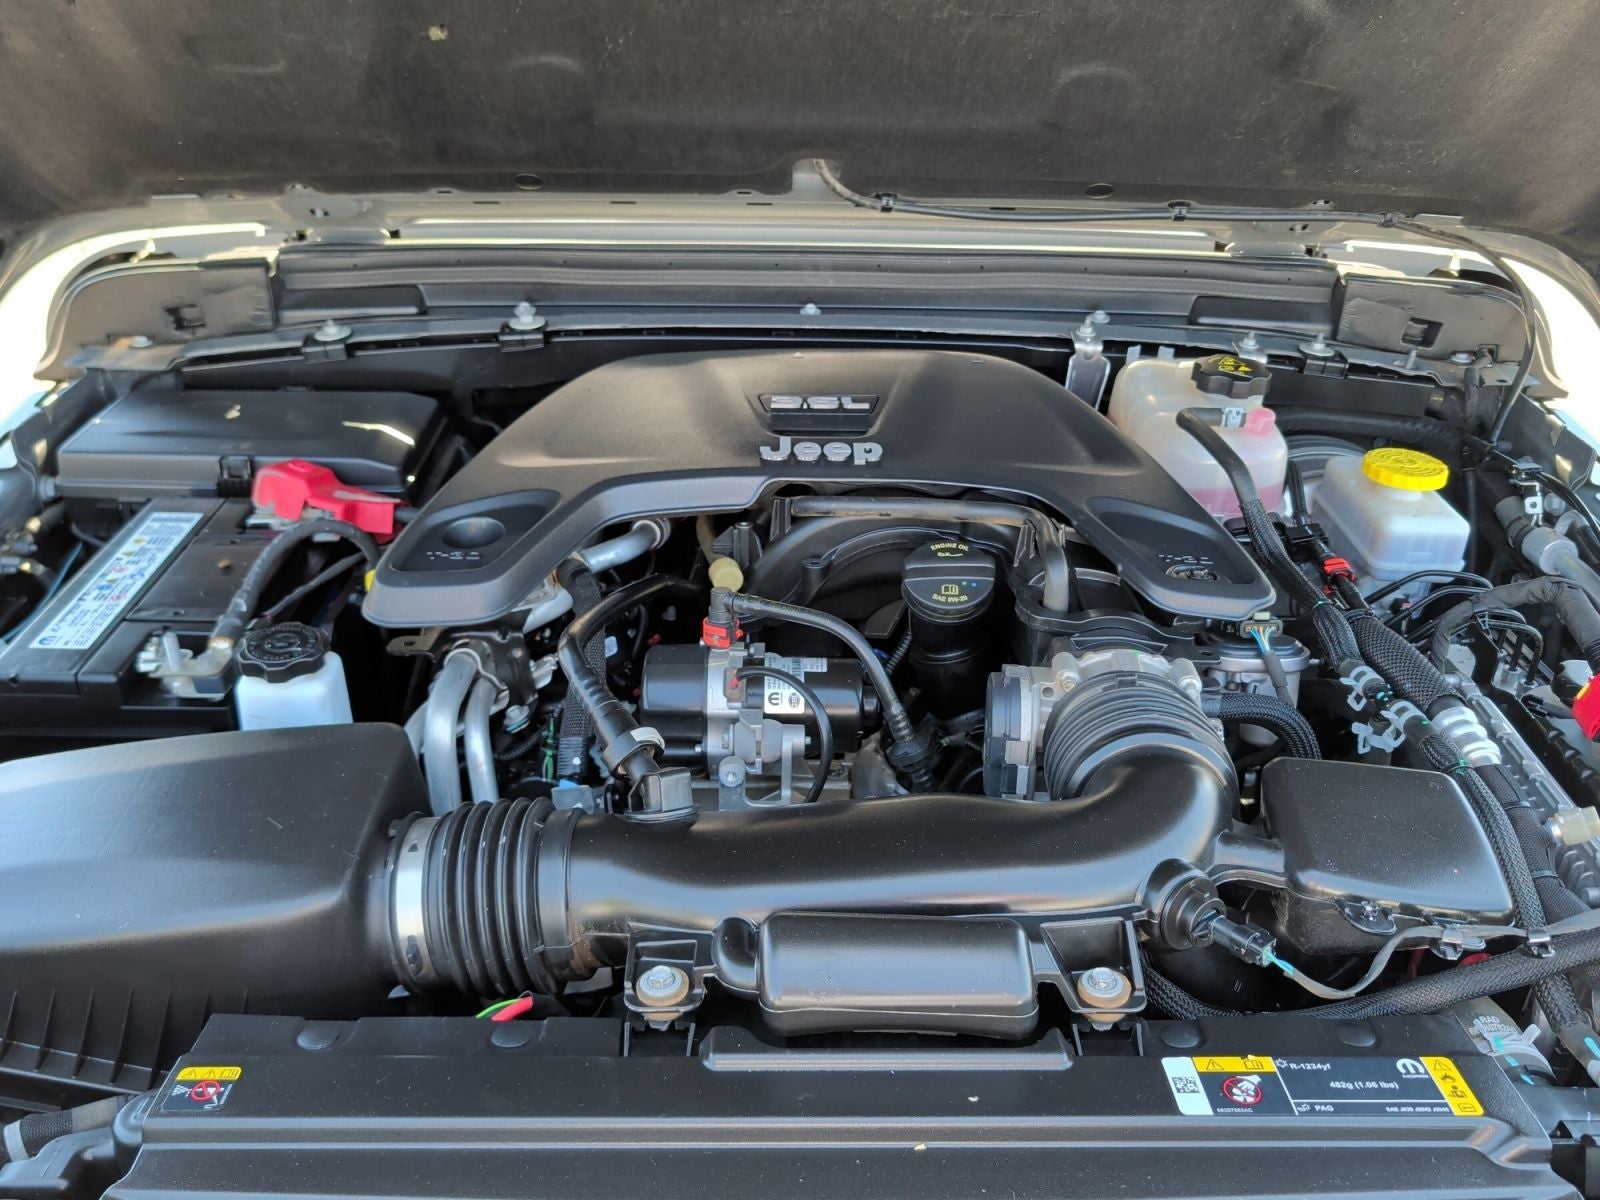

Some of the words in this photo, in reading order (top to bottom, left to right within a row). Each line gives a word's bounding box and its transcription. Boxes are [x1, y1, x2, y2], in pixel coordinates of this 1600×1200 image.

[770, 396, 870, 409] 3.6L
[759, 436, 883, 466] Jeep
[930, 542, 957, 551] ENGINE
[958, 544, 970, 552] OIL
[931, 593, 947, 602] SAE
[1478, 1015, 1500, 1024] RAD
[1289, 1062, 1331, 1071] R-1234yf
[1378, 1081, 1399, 1090] lbs)
